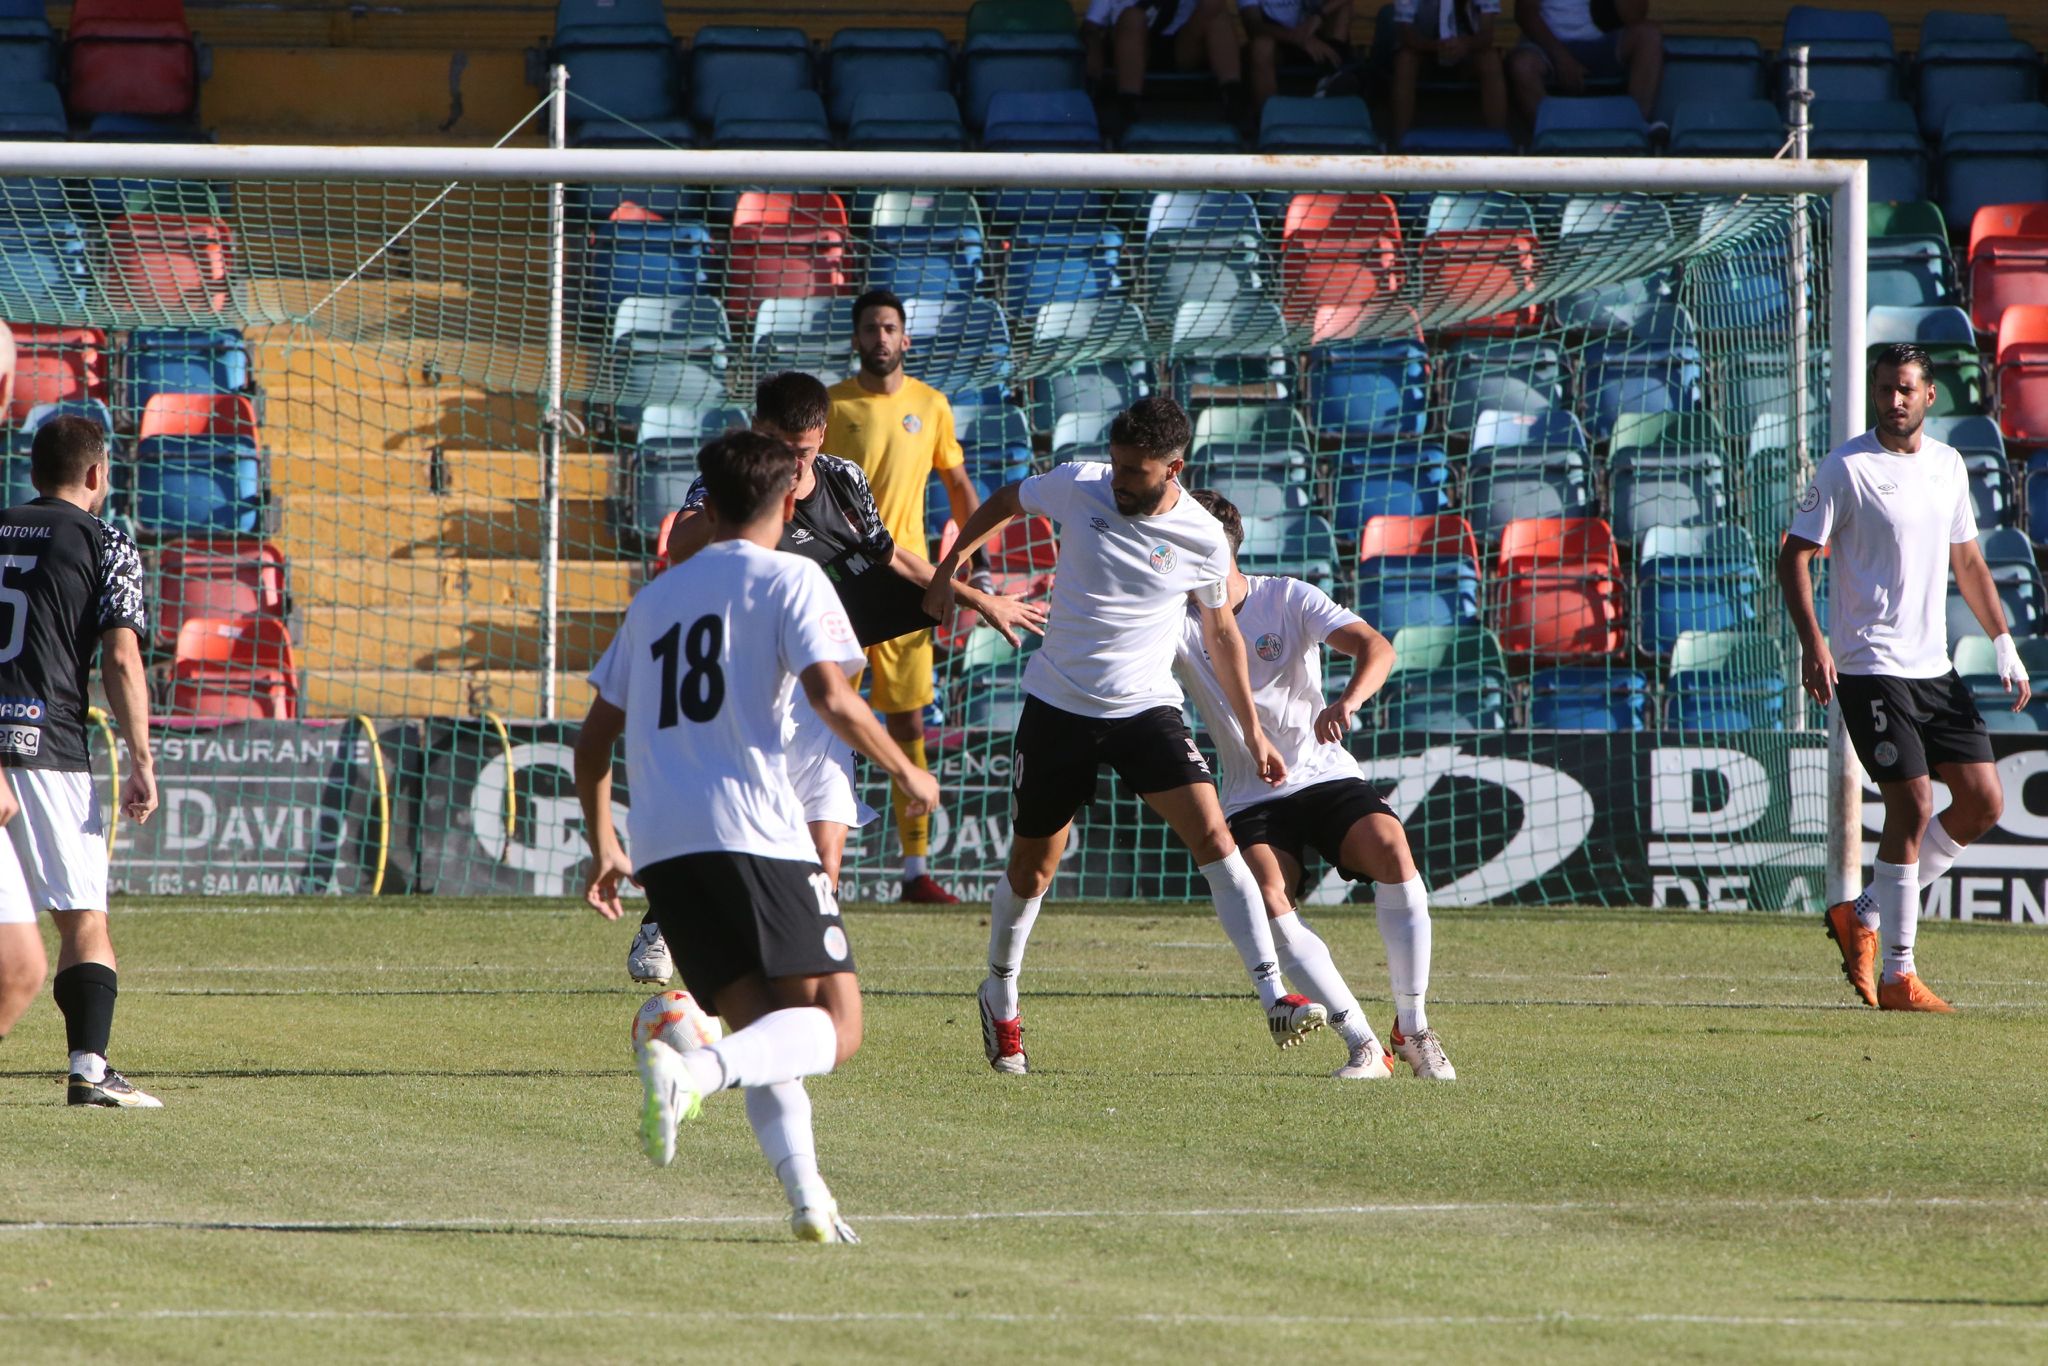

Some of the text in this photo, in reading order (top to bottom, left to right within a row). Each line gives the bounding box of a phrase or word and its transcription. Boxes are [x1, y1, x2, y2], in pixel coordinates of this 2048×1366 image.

[651, 614, 725, 729] 18
[0, 703, 40, 719] ADO
[1870, 699, 1888, 733] 5
[116, 737, 370, 764] RESTAURANTE
[163, 787, 348, 851] DAVID
